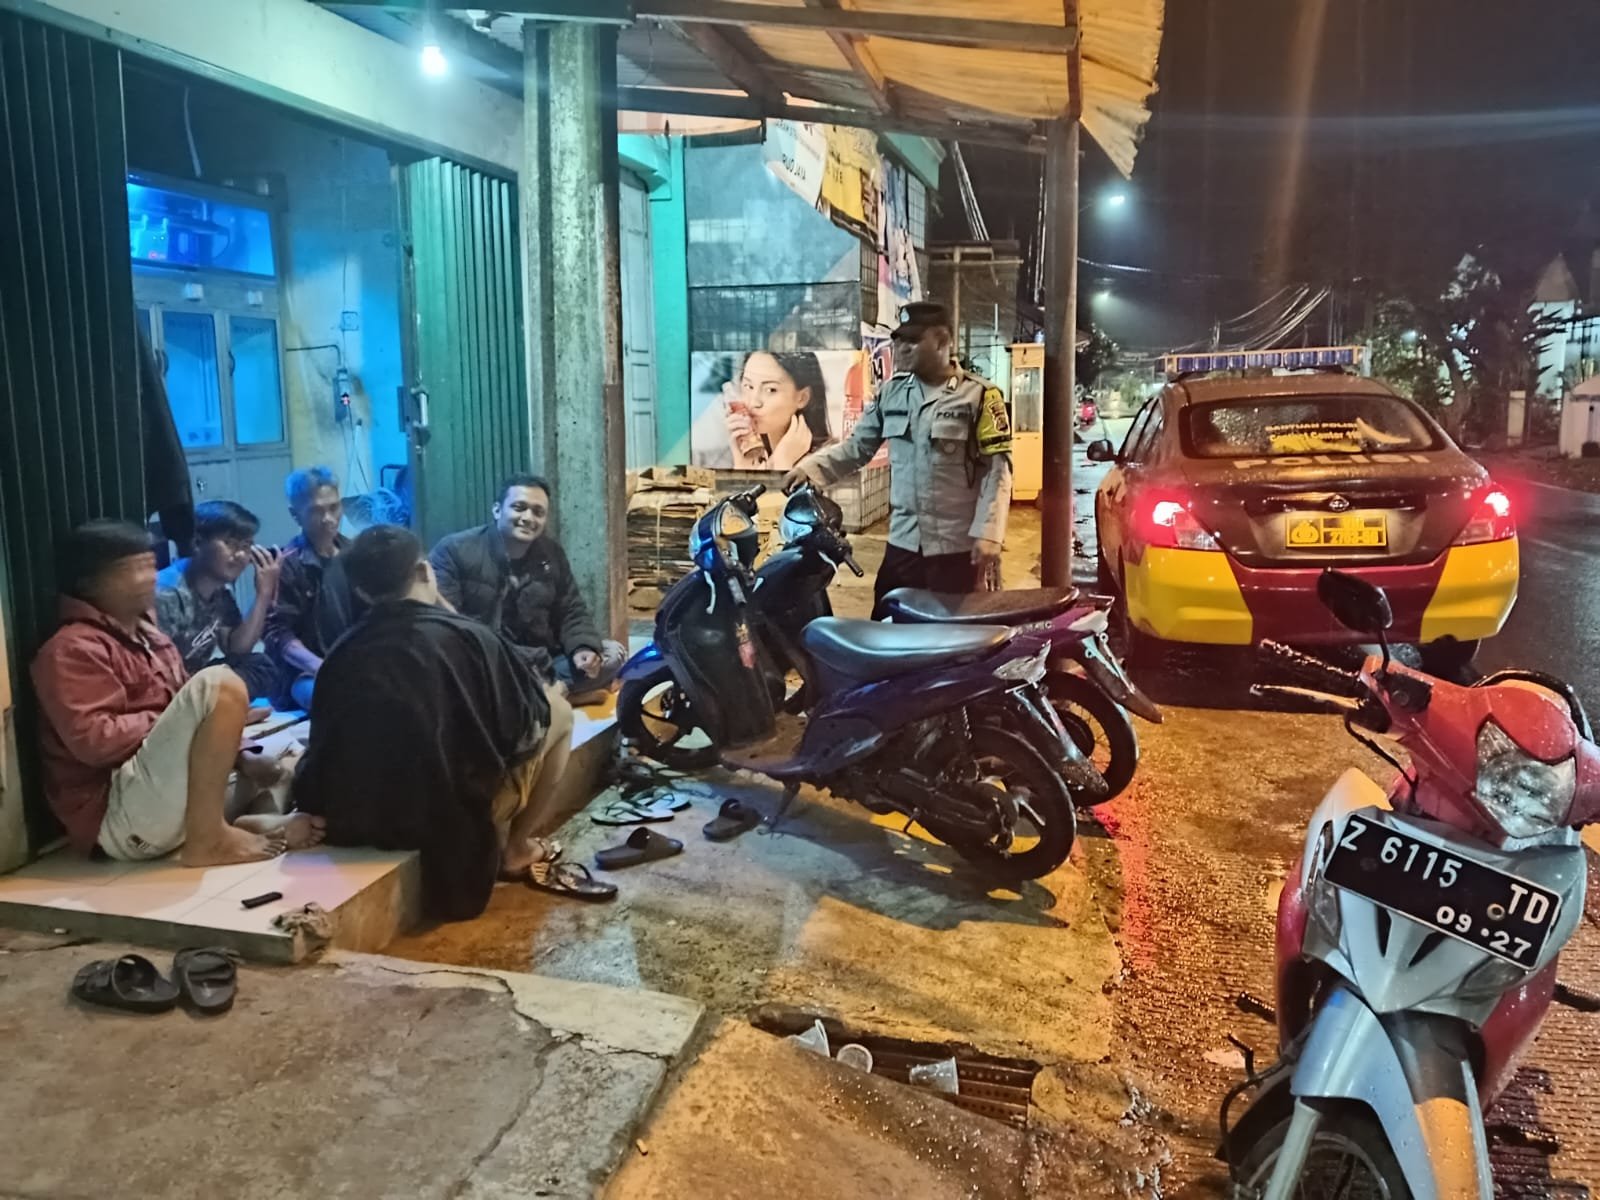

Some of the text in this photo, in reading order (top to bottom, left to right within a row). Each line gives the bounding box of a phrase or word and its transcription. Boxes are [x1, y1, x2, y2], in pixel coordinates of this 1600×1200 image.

[1265, 423, 1319, 433] BANTUAN
[1310, 431, 1343, 441] Center
[1233, 454, 1430, 469] POLISI
[1340, 821, 1550, 924] Z 6115 TD
